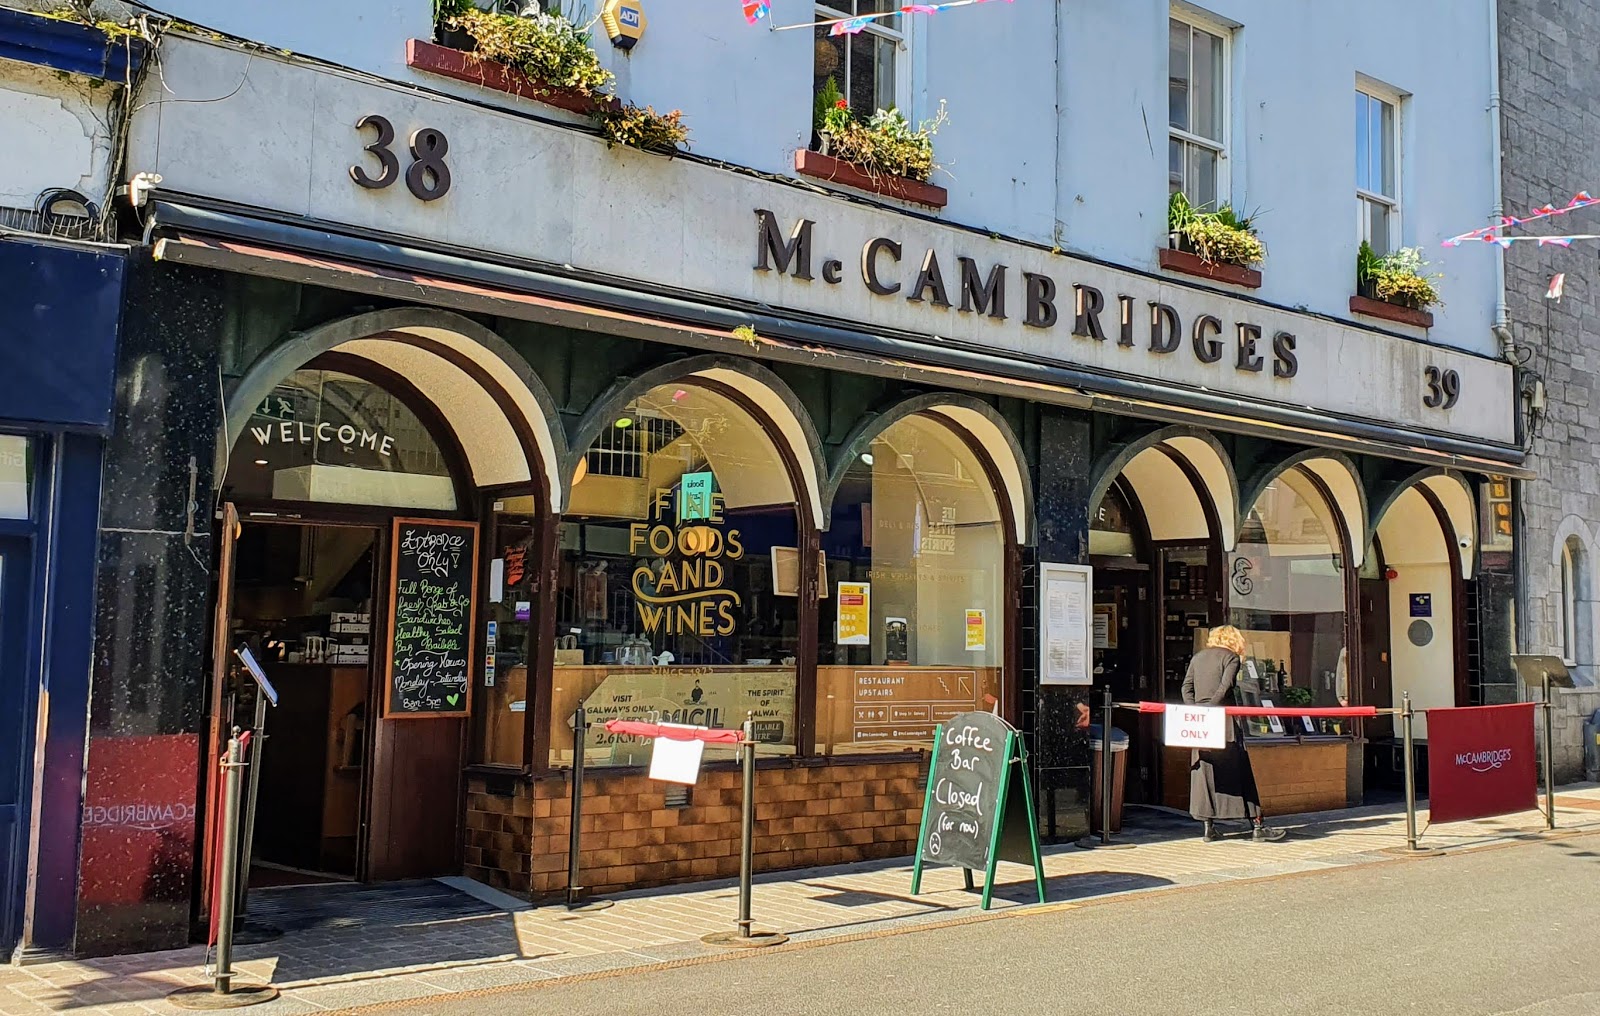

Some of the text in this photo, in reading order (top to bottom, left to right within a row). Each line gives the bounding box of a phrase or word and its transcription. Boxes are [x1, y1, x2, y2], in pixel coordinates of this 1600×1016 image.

[620, 10, 640, 24] ADT
[349, 114, 452, 202] 38
[1423, 365, 1461, 410] 39
[250, 421, 395, 457] WELCOME
[655, 487, 726, 528] FINE
[402, 529, 465, 554] Entrance
[629, 522, 745, 561] FOODS
[632, 560, 726, 601] AND
[636, 600, 736, 637] WINES
[650, 666, 685, 677] SINCE
[858, 677, 905, 685] RESTAURANT
[612, 695, 633, 703] VISIT
[762, 689, 785, 697] SPIRIT
[858, 688, 894, 697] UPSTAIRS
[632, 705, 655, 714] ONLY
[760, 699, 771, 707] OF
[751, 709, 780, 717] ALWAY
[1184, 712, 1207, 724] EXIT
[946, 726, 993, 751] Coffee
[1180, 729, 1209, 740] ONLY
[951, 748, 980, 771] Bar
[935, 777, 983, 816] Closed
